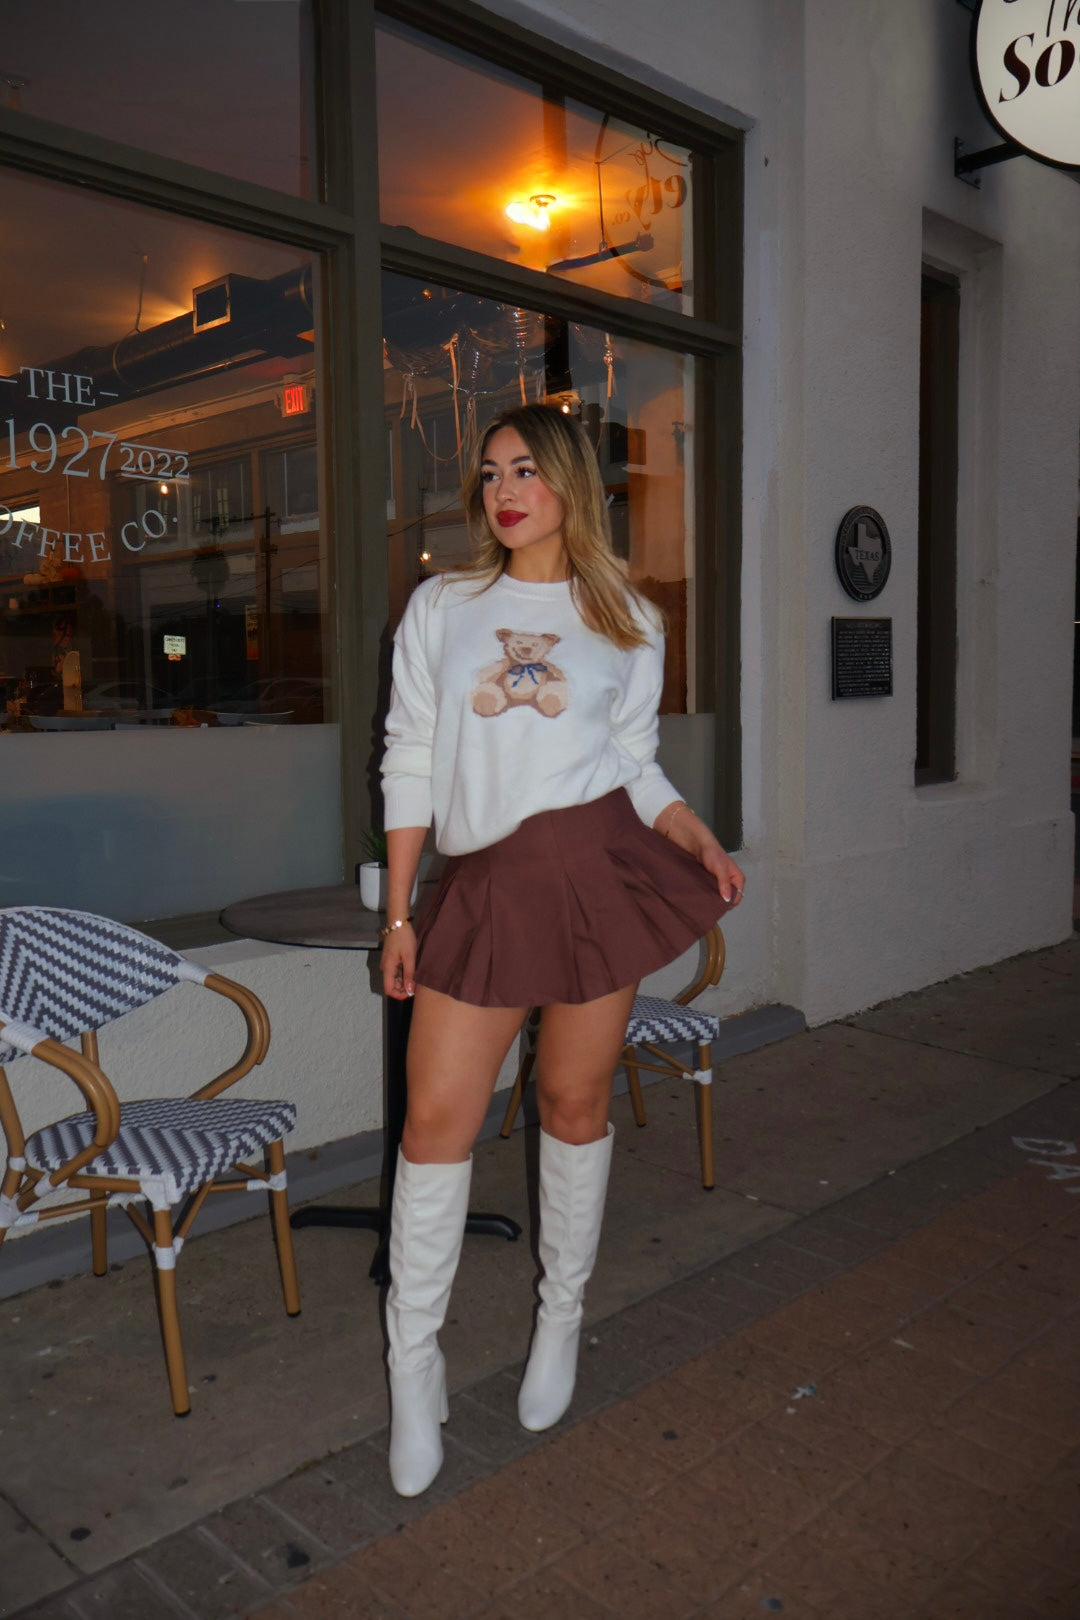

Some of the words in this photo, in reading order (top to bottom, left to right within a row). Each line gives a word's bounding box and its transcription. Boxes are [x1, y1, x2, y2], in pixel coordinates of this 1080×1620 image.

[999, 33, 1080, 103] So
[284, 386, 304, 414] EXIT
[5, 418, 118, 481] 1927
[120, 446, 190, 480] 2022
[855, 549, 880, 562] TEXAS
